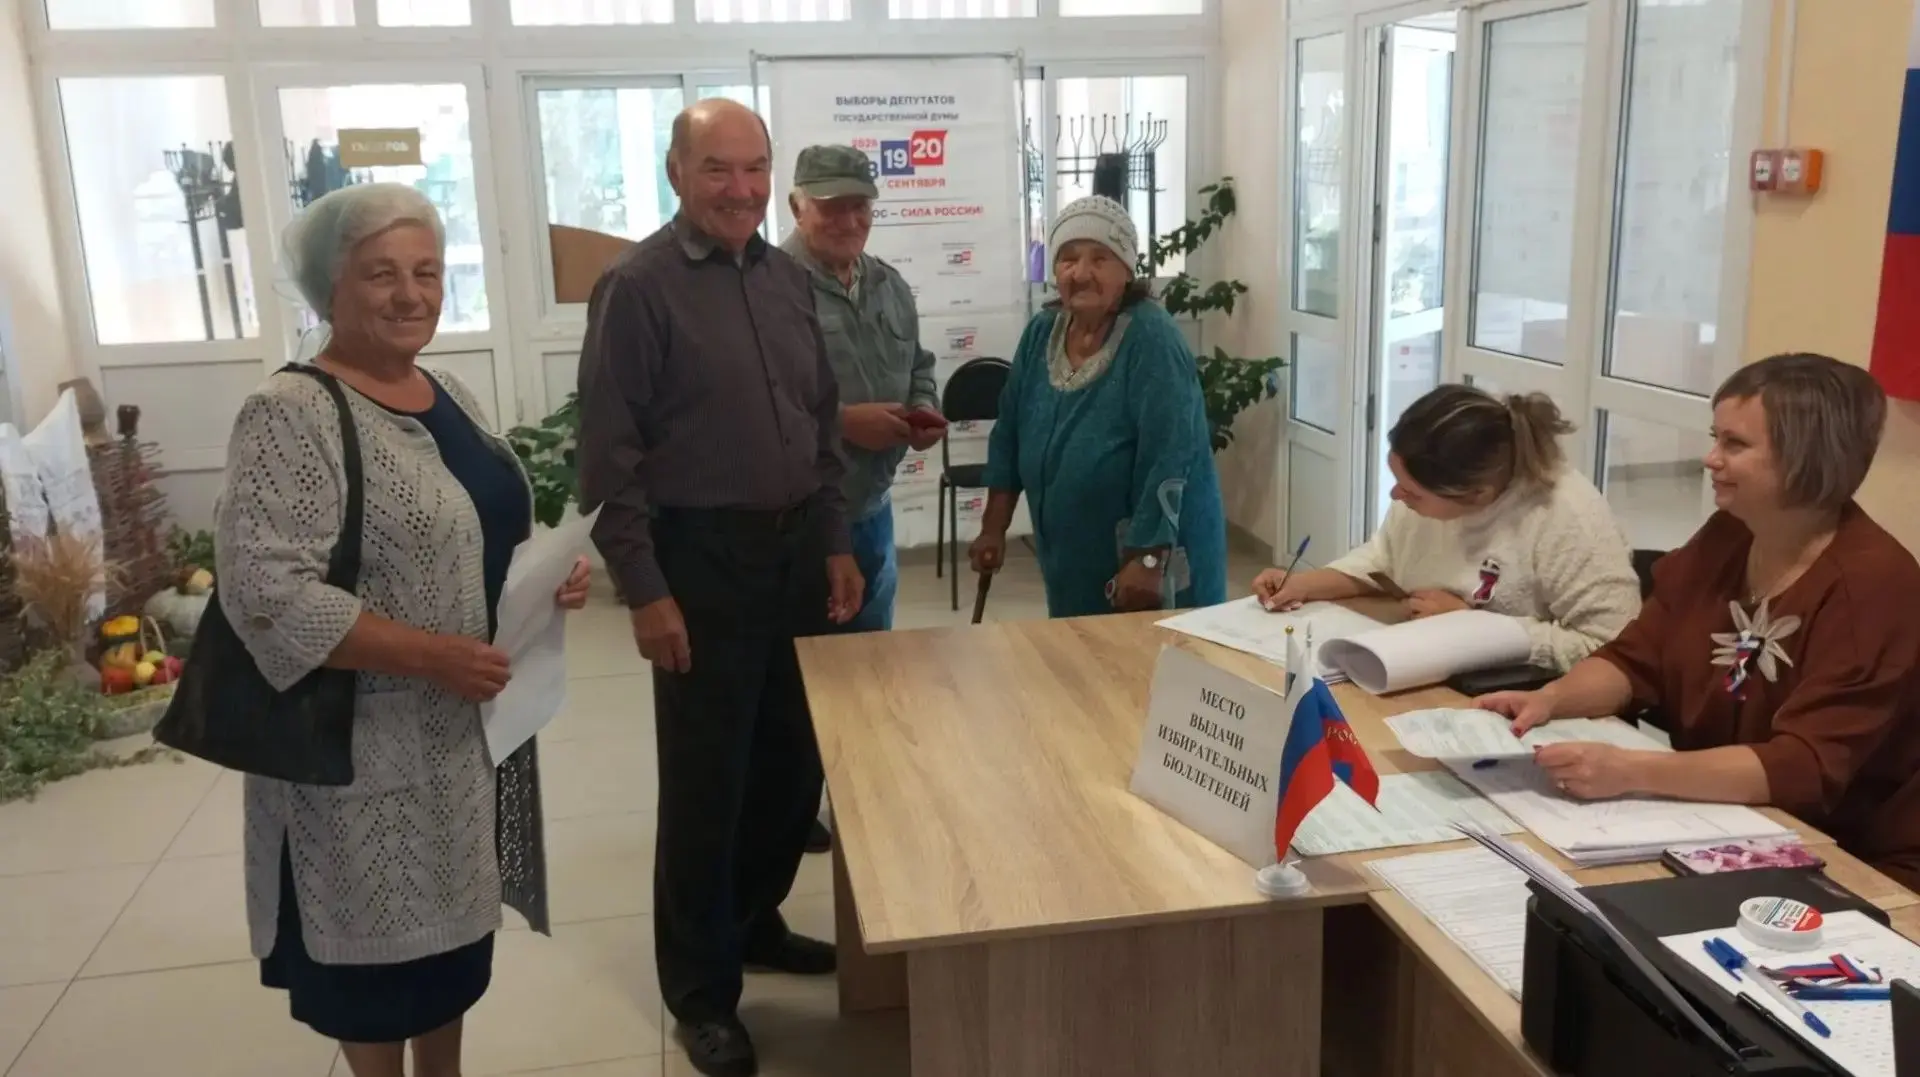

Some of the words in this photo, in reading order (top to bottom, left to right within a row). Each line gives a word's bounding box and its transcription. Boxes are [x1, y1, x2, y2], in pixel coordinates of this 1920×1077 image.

[833, 111, 928, 122] ГОСУДАРСТВЕННОЙ
[930, 112, 959, 122] ДУМЫ
[836, 96, 887, 106] ВЫБОРЫ
[889, 95, 955, 107] ДЕПУТАТОВ
[884, 148, 908, 169] 19
[912, 138, 942, 159] 20
[887, 178, 946, 189] СЕНТЯБРЯ
[900, 207, 932, 218] СИЛА
[1199, 687, 1246, 720] МЕСТО
[1189, 712, 1244, 752] ВЫДАЧИ
[1157, 723, 1269, 793] ИЗБИРАТЕЛЬНЫХ
[1162, 752, 1251, 813] БЮЛЛЕТЕНЕЙ
